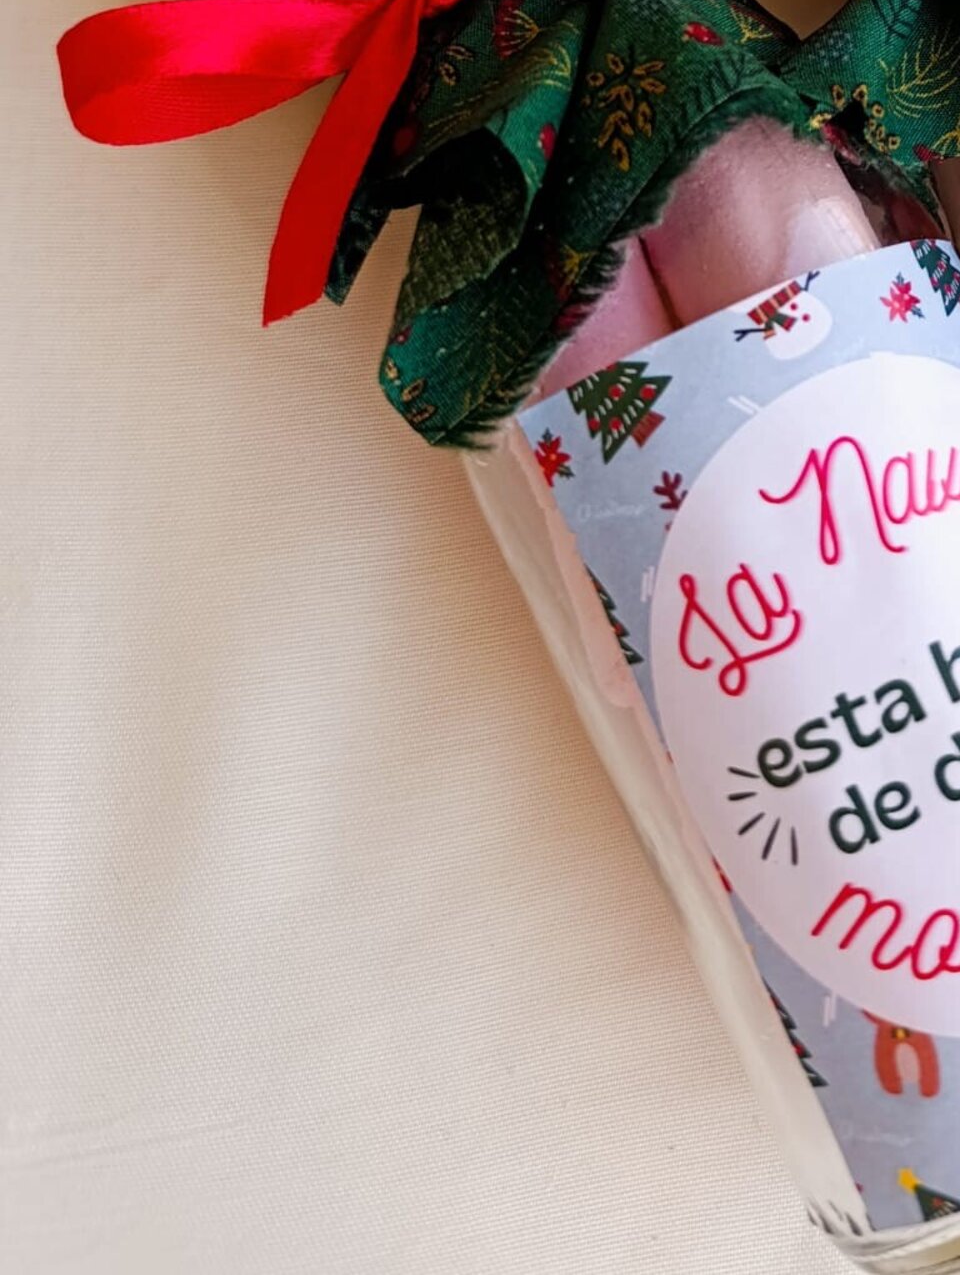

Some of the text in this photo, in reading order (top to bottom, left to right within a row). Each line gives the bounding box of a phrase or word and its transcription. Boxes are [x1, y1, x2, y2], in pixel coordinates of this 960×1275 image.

[678, 563, 803, 699] La
[757, 674, 926, 789] esta
[827, 785, 921, 856] de
